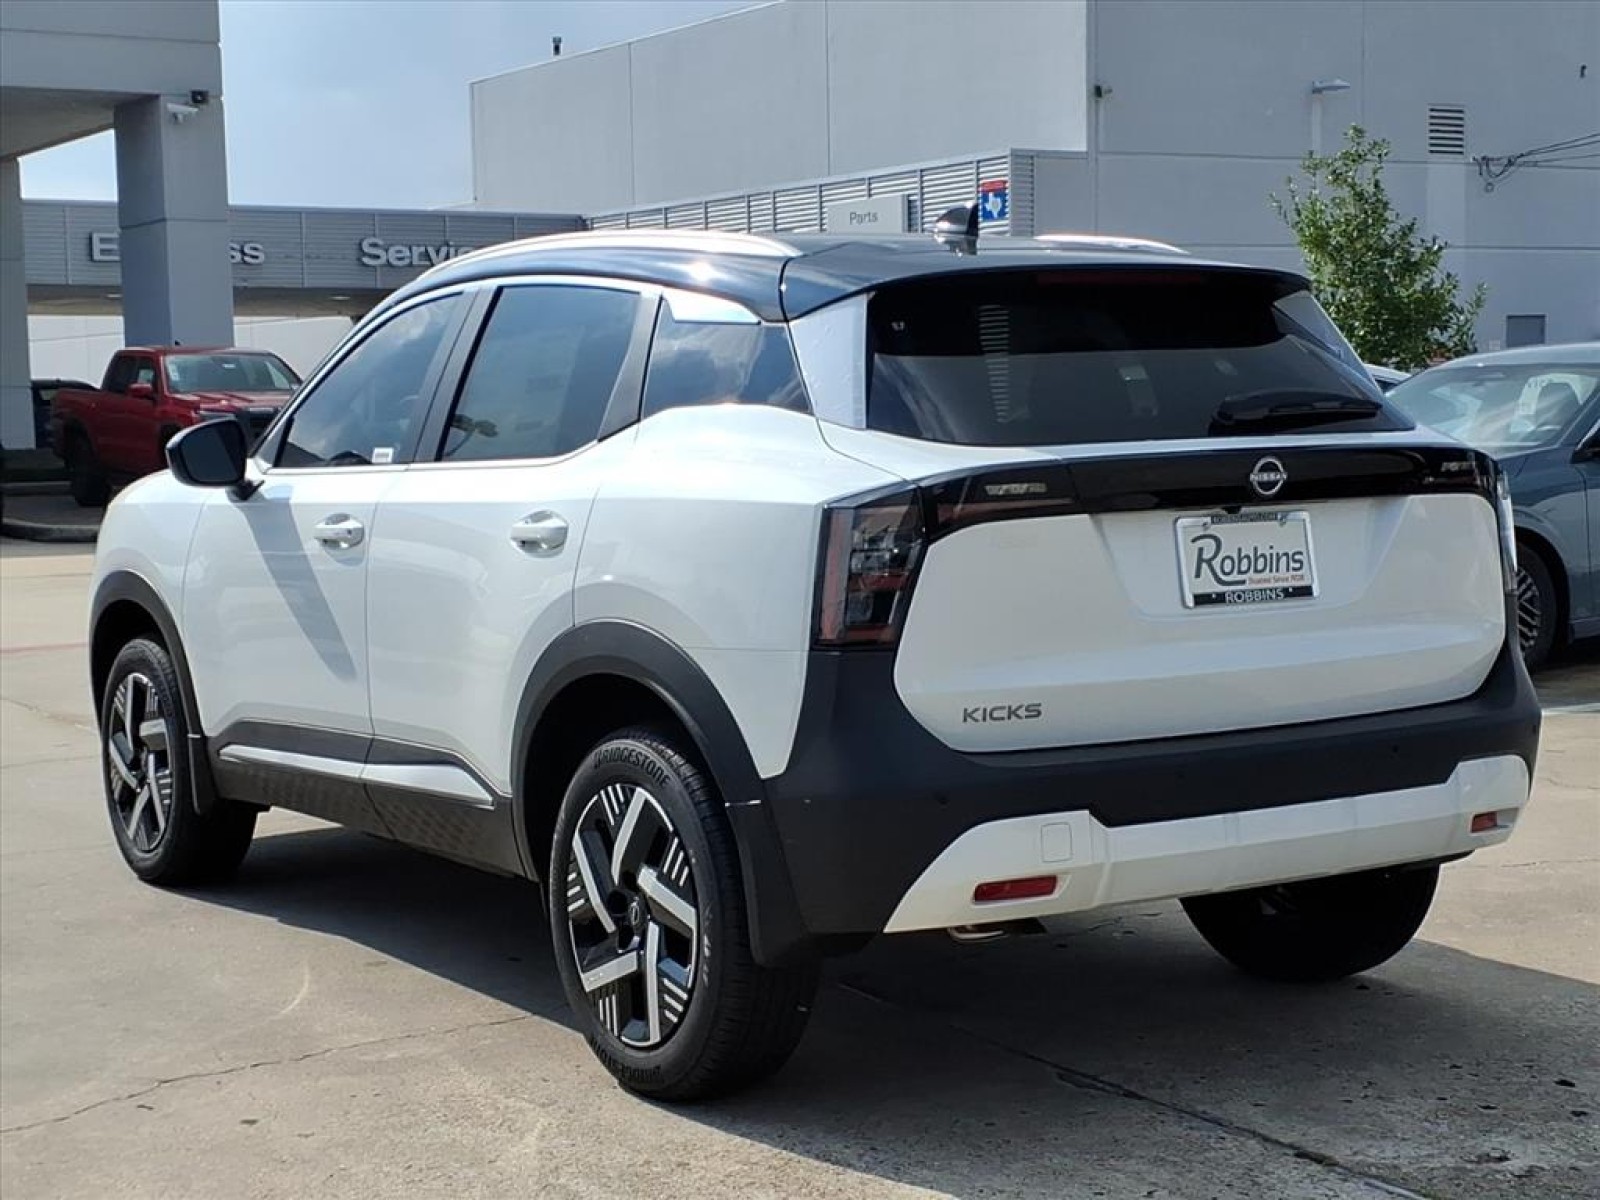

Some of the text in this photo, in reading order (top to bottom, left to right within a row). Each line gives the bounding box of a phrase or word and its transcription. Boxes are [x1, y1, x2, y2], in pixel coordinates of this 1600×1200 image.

[850, 211, 878, 226] Parts
[1190, 533, 1304, 586] Robbins
[1225, 588, 1285, 603] ROBBINS
[962, 702, 1042, 722] KICKS
